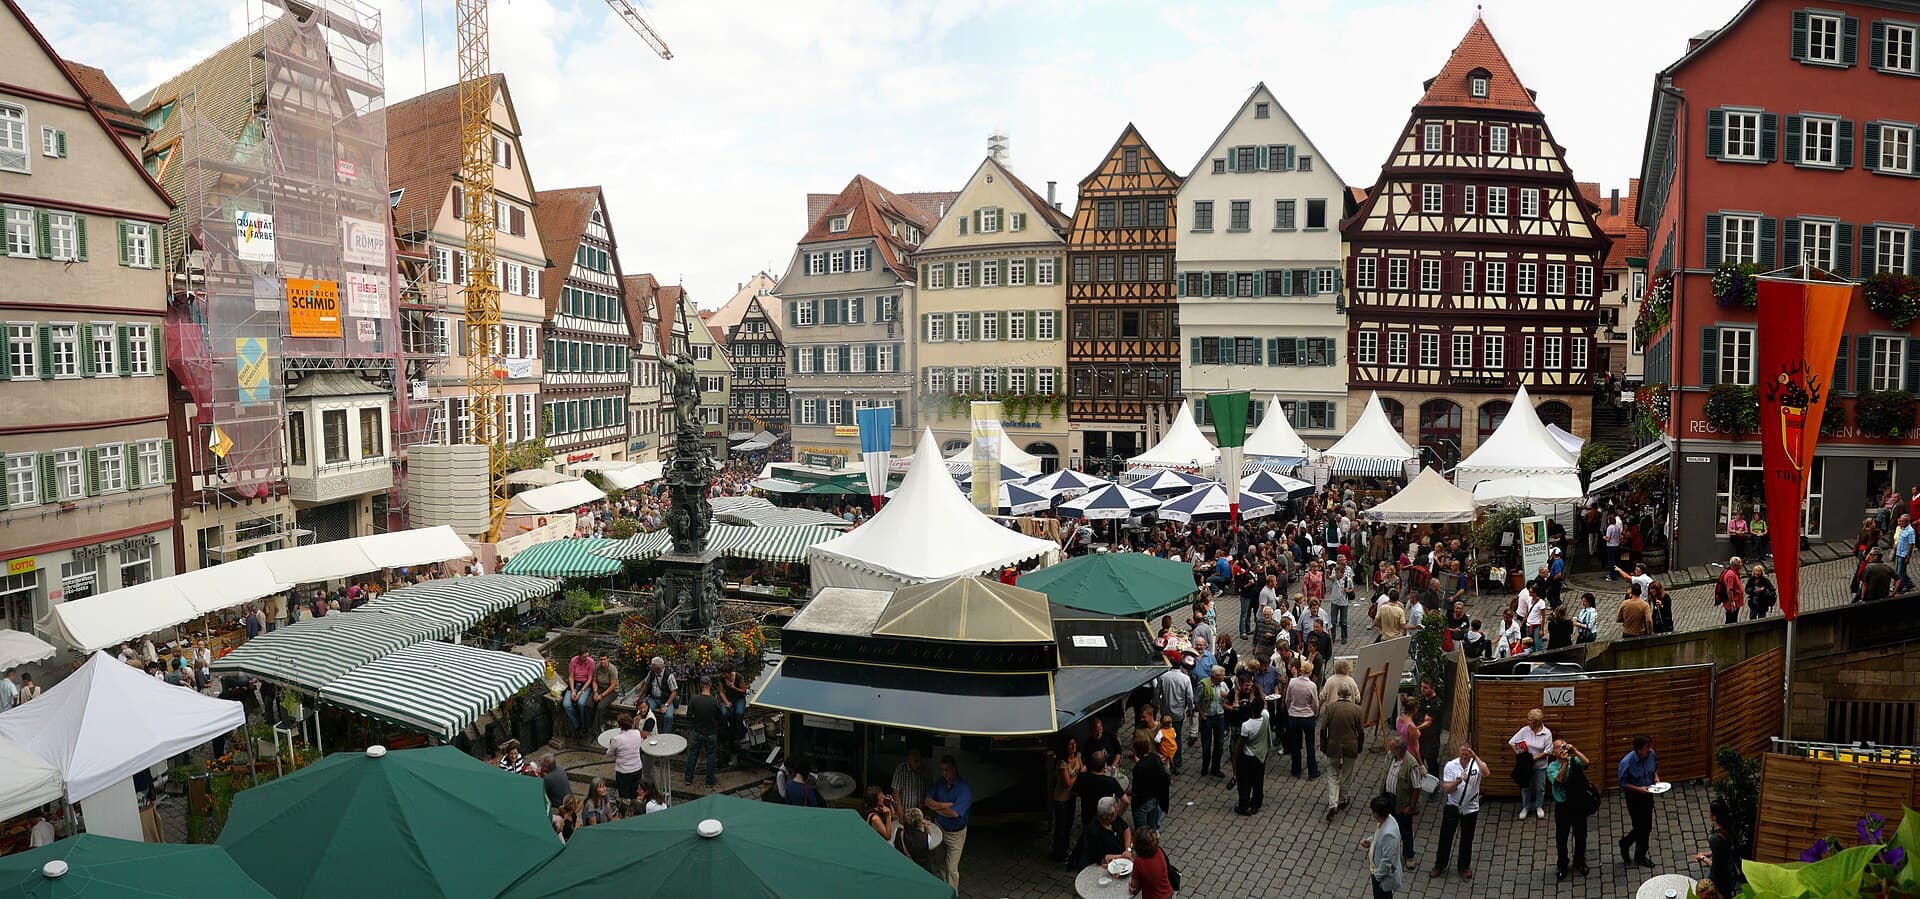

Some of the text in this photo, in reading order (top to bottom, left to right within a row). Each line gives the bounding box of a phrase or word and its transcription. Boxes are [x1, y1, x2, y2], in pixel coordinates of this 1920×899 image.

[236, 218, 272, 230] QUALITÄT
[237, 229, 273, 240] IN FARBE
[291, 288, 335, 297] FRIEDRICH
[291, 295, 336, 310] SCHMID
[11, 560, 35, 571] LOTTO
[1547, 690, 1573, 704] WC
